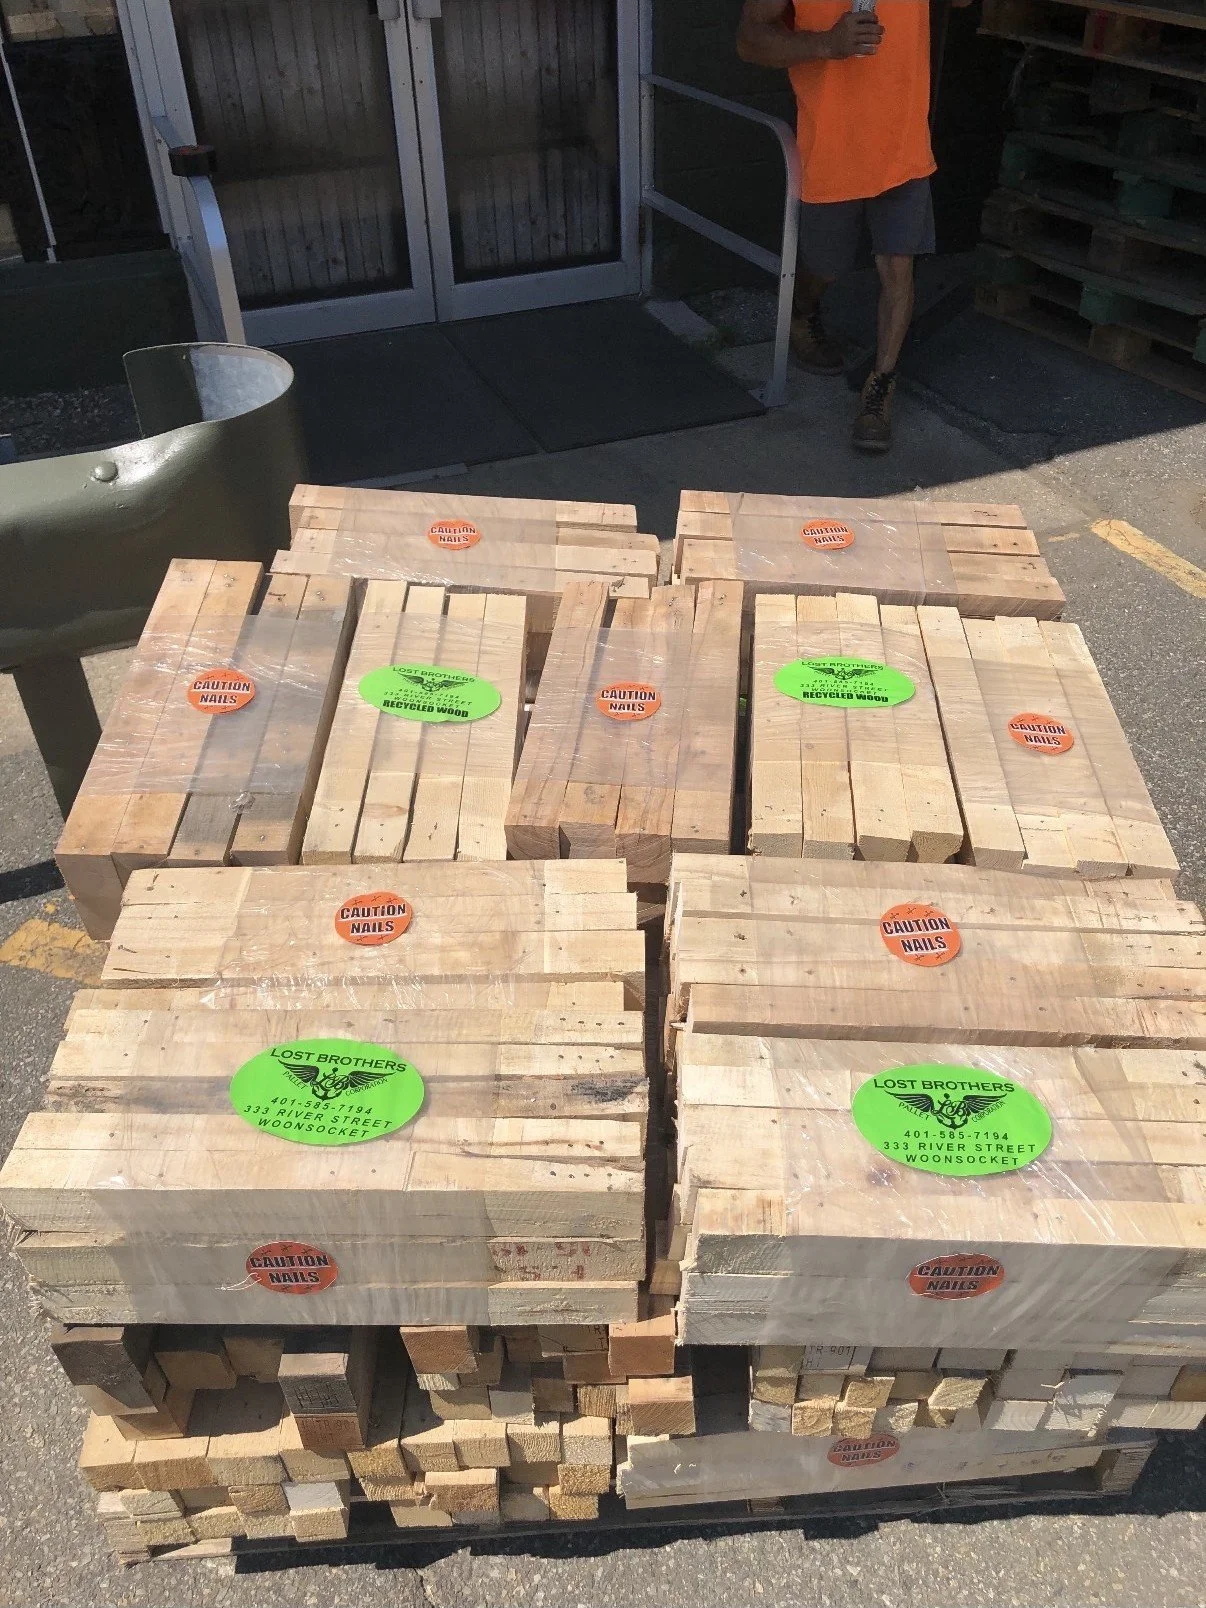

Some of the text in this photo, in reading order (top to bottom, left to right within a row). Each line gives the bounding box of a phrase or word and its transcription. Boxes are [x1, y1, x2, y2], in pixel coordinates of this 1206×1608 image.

[430, 526, 476, 534] CAUTION
[802, 526, 849, 536] CAUTION
[439, 535, 469, 543] NAILS
[813, 535, 845, 544] NAILS
[829, 662, 884, 671] BROTHERS
[392, 666, 420, 675] LOST
[420, 670, 476, 683] BROTHERS
[192, 680, 251, 692] CAUTION
[199, 693, 238, 704] NAILS
[601, 689, 657, 701] CAUTION
[802, 691, 889, 703] RECYCLED WOOD
[382, 699, 469, 718] RECYCLED WOOD
[609, 702, 646, 712] NAILS
[1009, 723, 1067, 735] CAUTION
[1023, 734, 1061, 746] NAILS
[340, 903, 406, 919] CAUTION
[350, 920, 395, 934] NAILS
[881, 917, 951, 934] CAUTION
[901, 935, 947, 953] NAILS
[270, 1048, 407, 1073] LOST BROTHERS
[282, 1070, 309, 1090] PALLET
[873, 1078, 1015, 1093] LOST BROTHERS
[345, 1077, 389, 1097] CORPORATION
[270, 1096, 373, 1115] 401-585-7194
[898, 1101, 931, 1120] PALLET
[971, 1099, 1007, 1122] CORPORATION
[243, 1104, 393, 1129] 333 RIVER STREET
[258, 1117, 370, 1138] WOONSOCKET
[904, 1130, 1009, 1141] 401-585-7194
[883, 1141, 1036, 1153] 333 RIVER STREET
[905, 1154, 1019, 1166] WOONSOCKET
[249, 1254, 329, 1269] CAUTION
[917, 1265, 1000, 1276] CAUTION
[268, 1271, 320, 1283] NAILS
[926, 1280, 980, 1291] NAILS
[833, 1440, 897, 1453] CAUTION
[841, 1449, 882, 1462] NAILS
